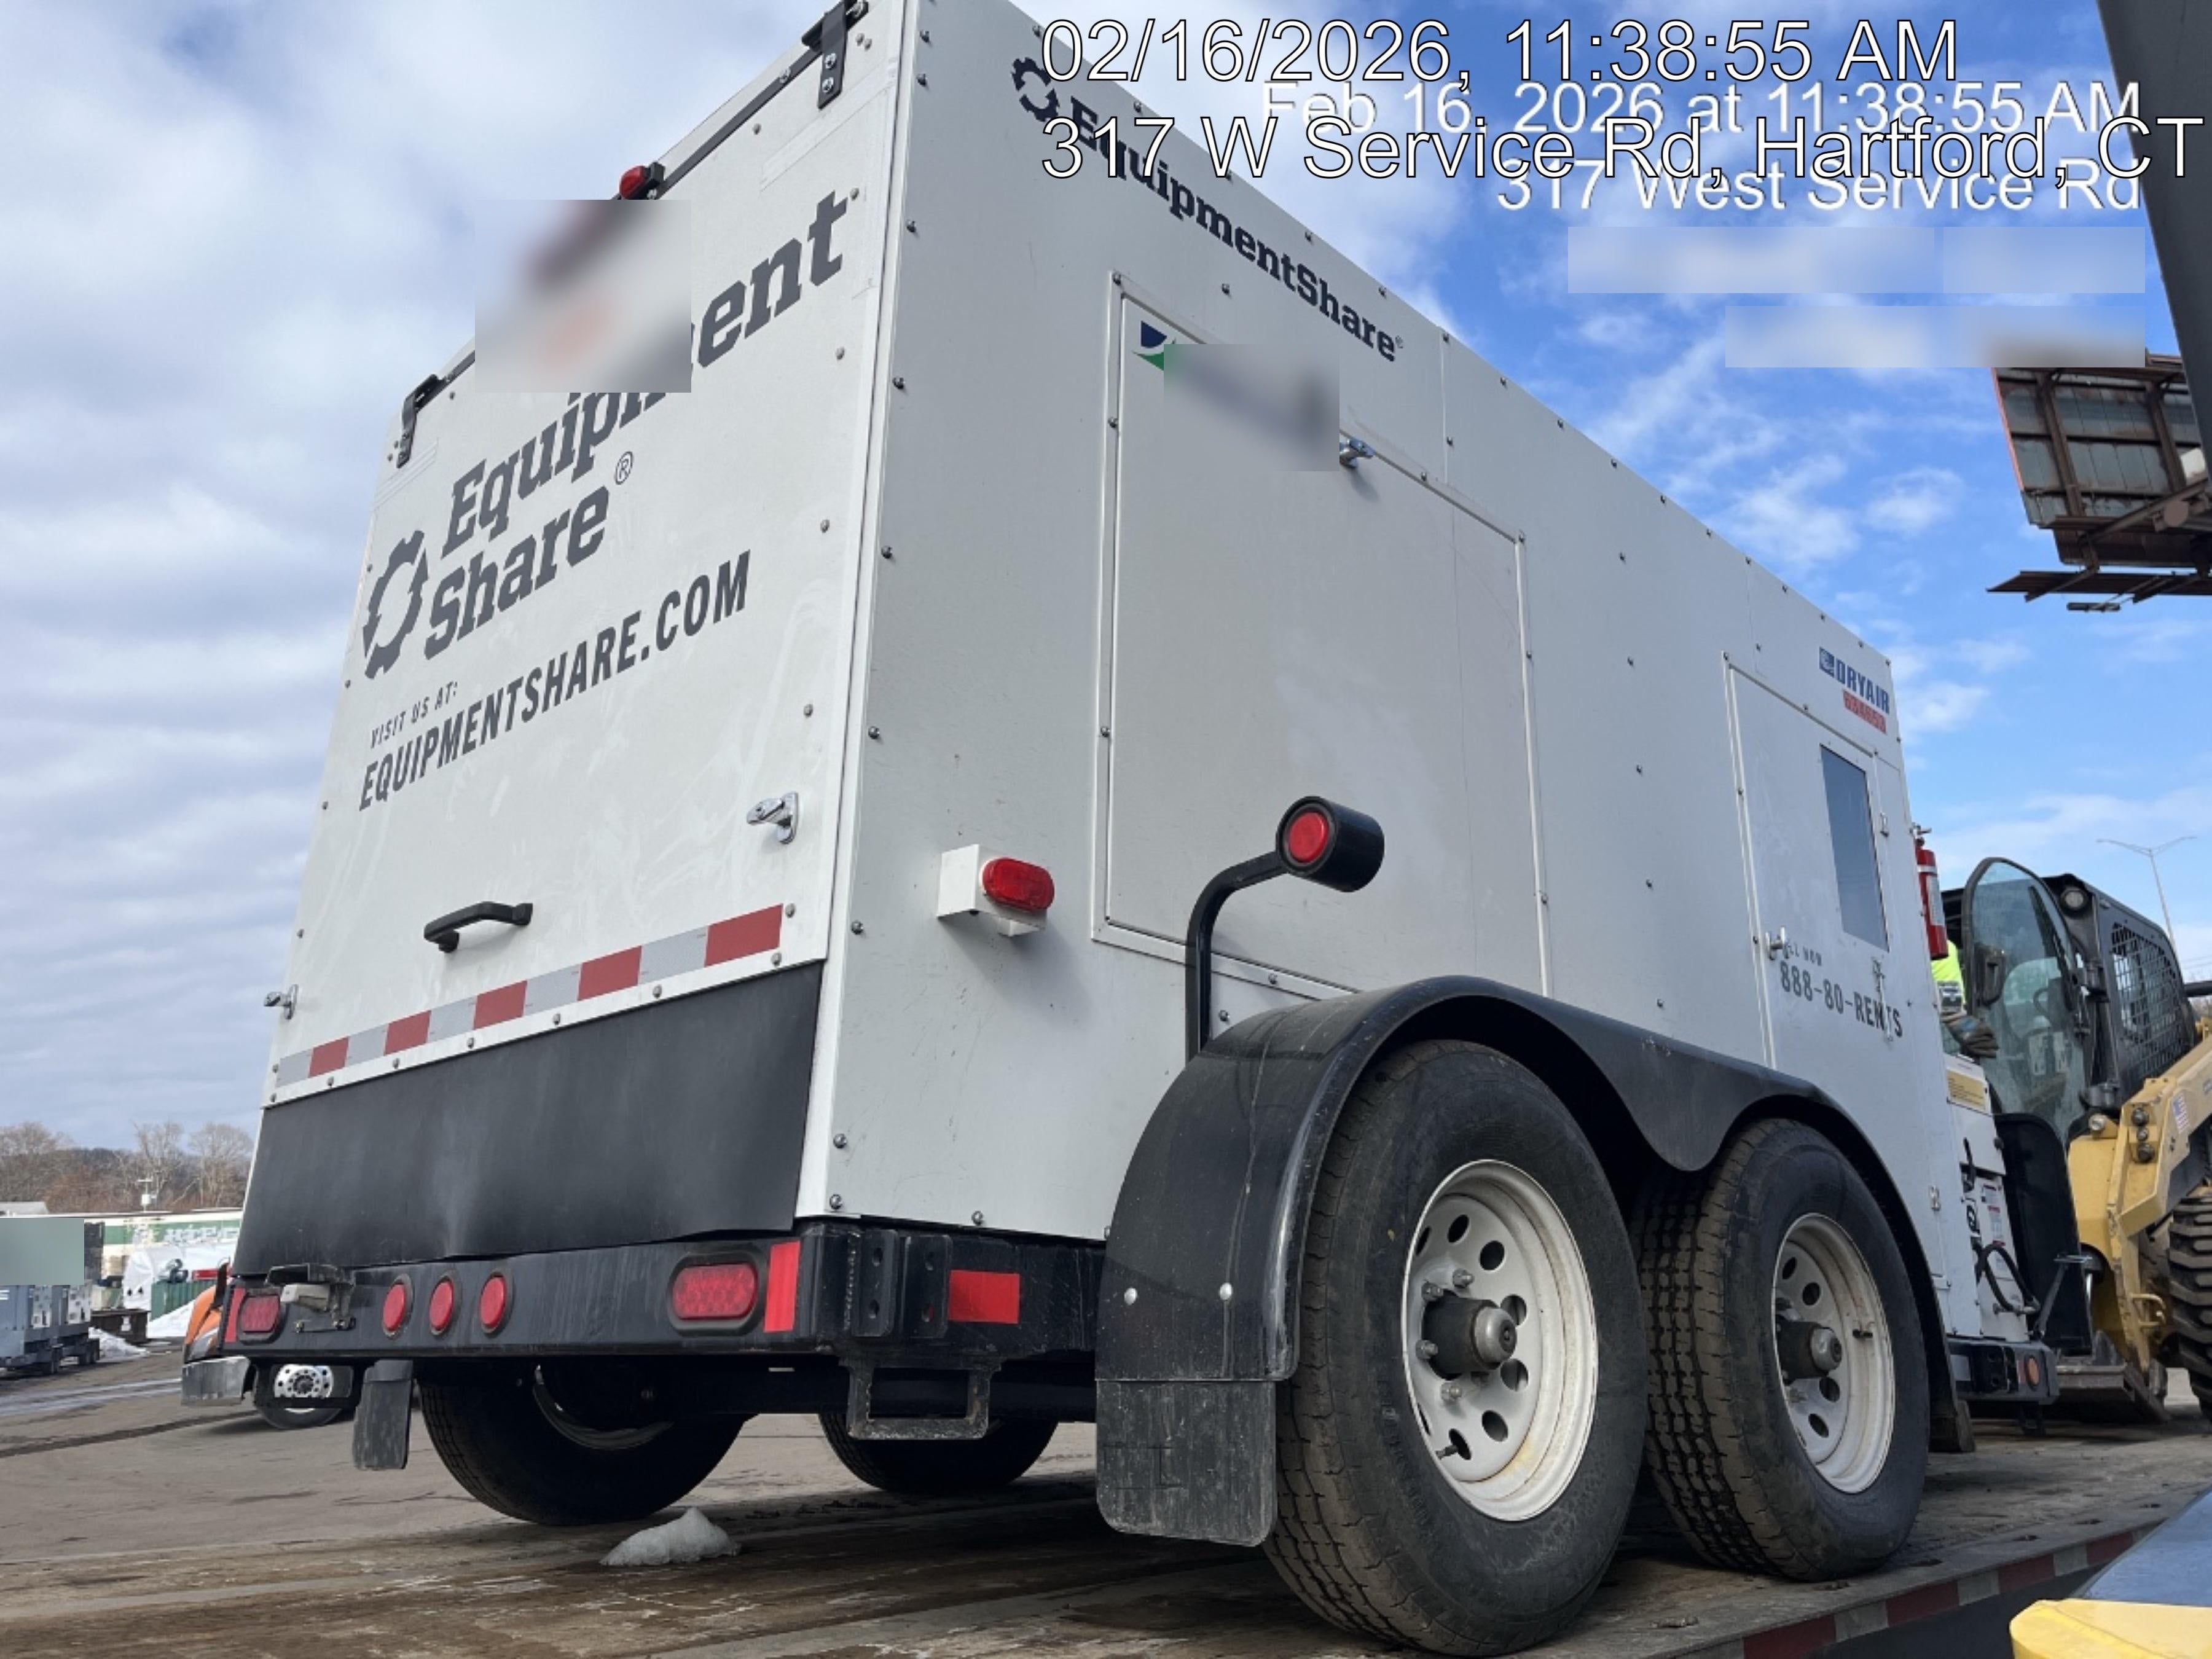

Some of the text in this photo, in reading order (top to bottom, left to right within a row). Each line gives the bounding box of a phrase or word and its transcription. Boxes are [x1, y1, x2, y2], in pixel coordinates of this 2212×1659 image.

[441, 190, 852, 560] Equipent
[423, 485, 610, 661] Share
[359, 549, 750, 812] EQUIPMENTSHARE.COM
[371, 681, 457, 749] VISIT US AT:
[1836, 657, 1890, 715] DRYAIR
